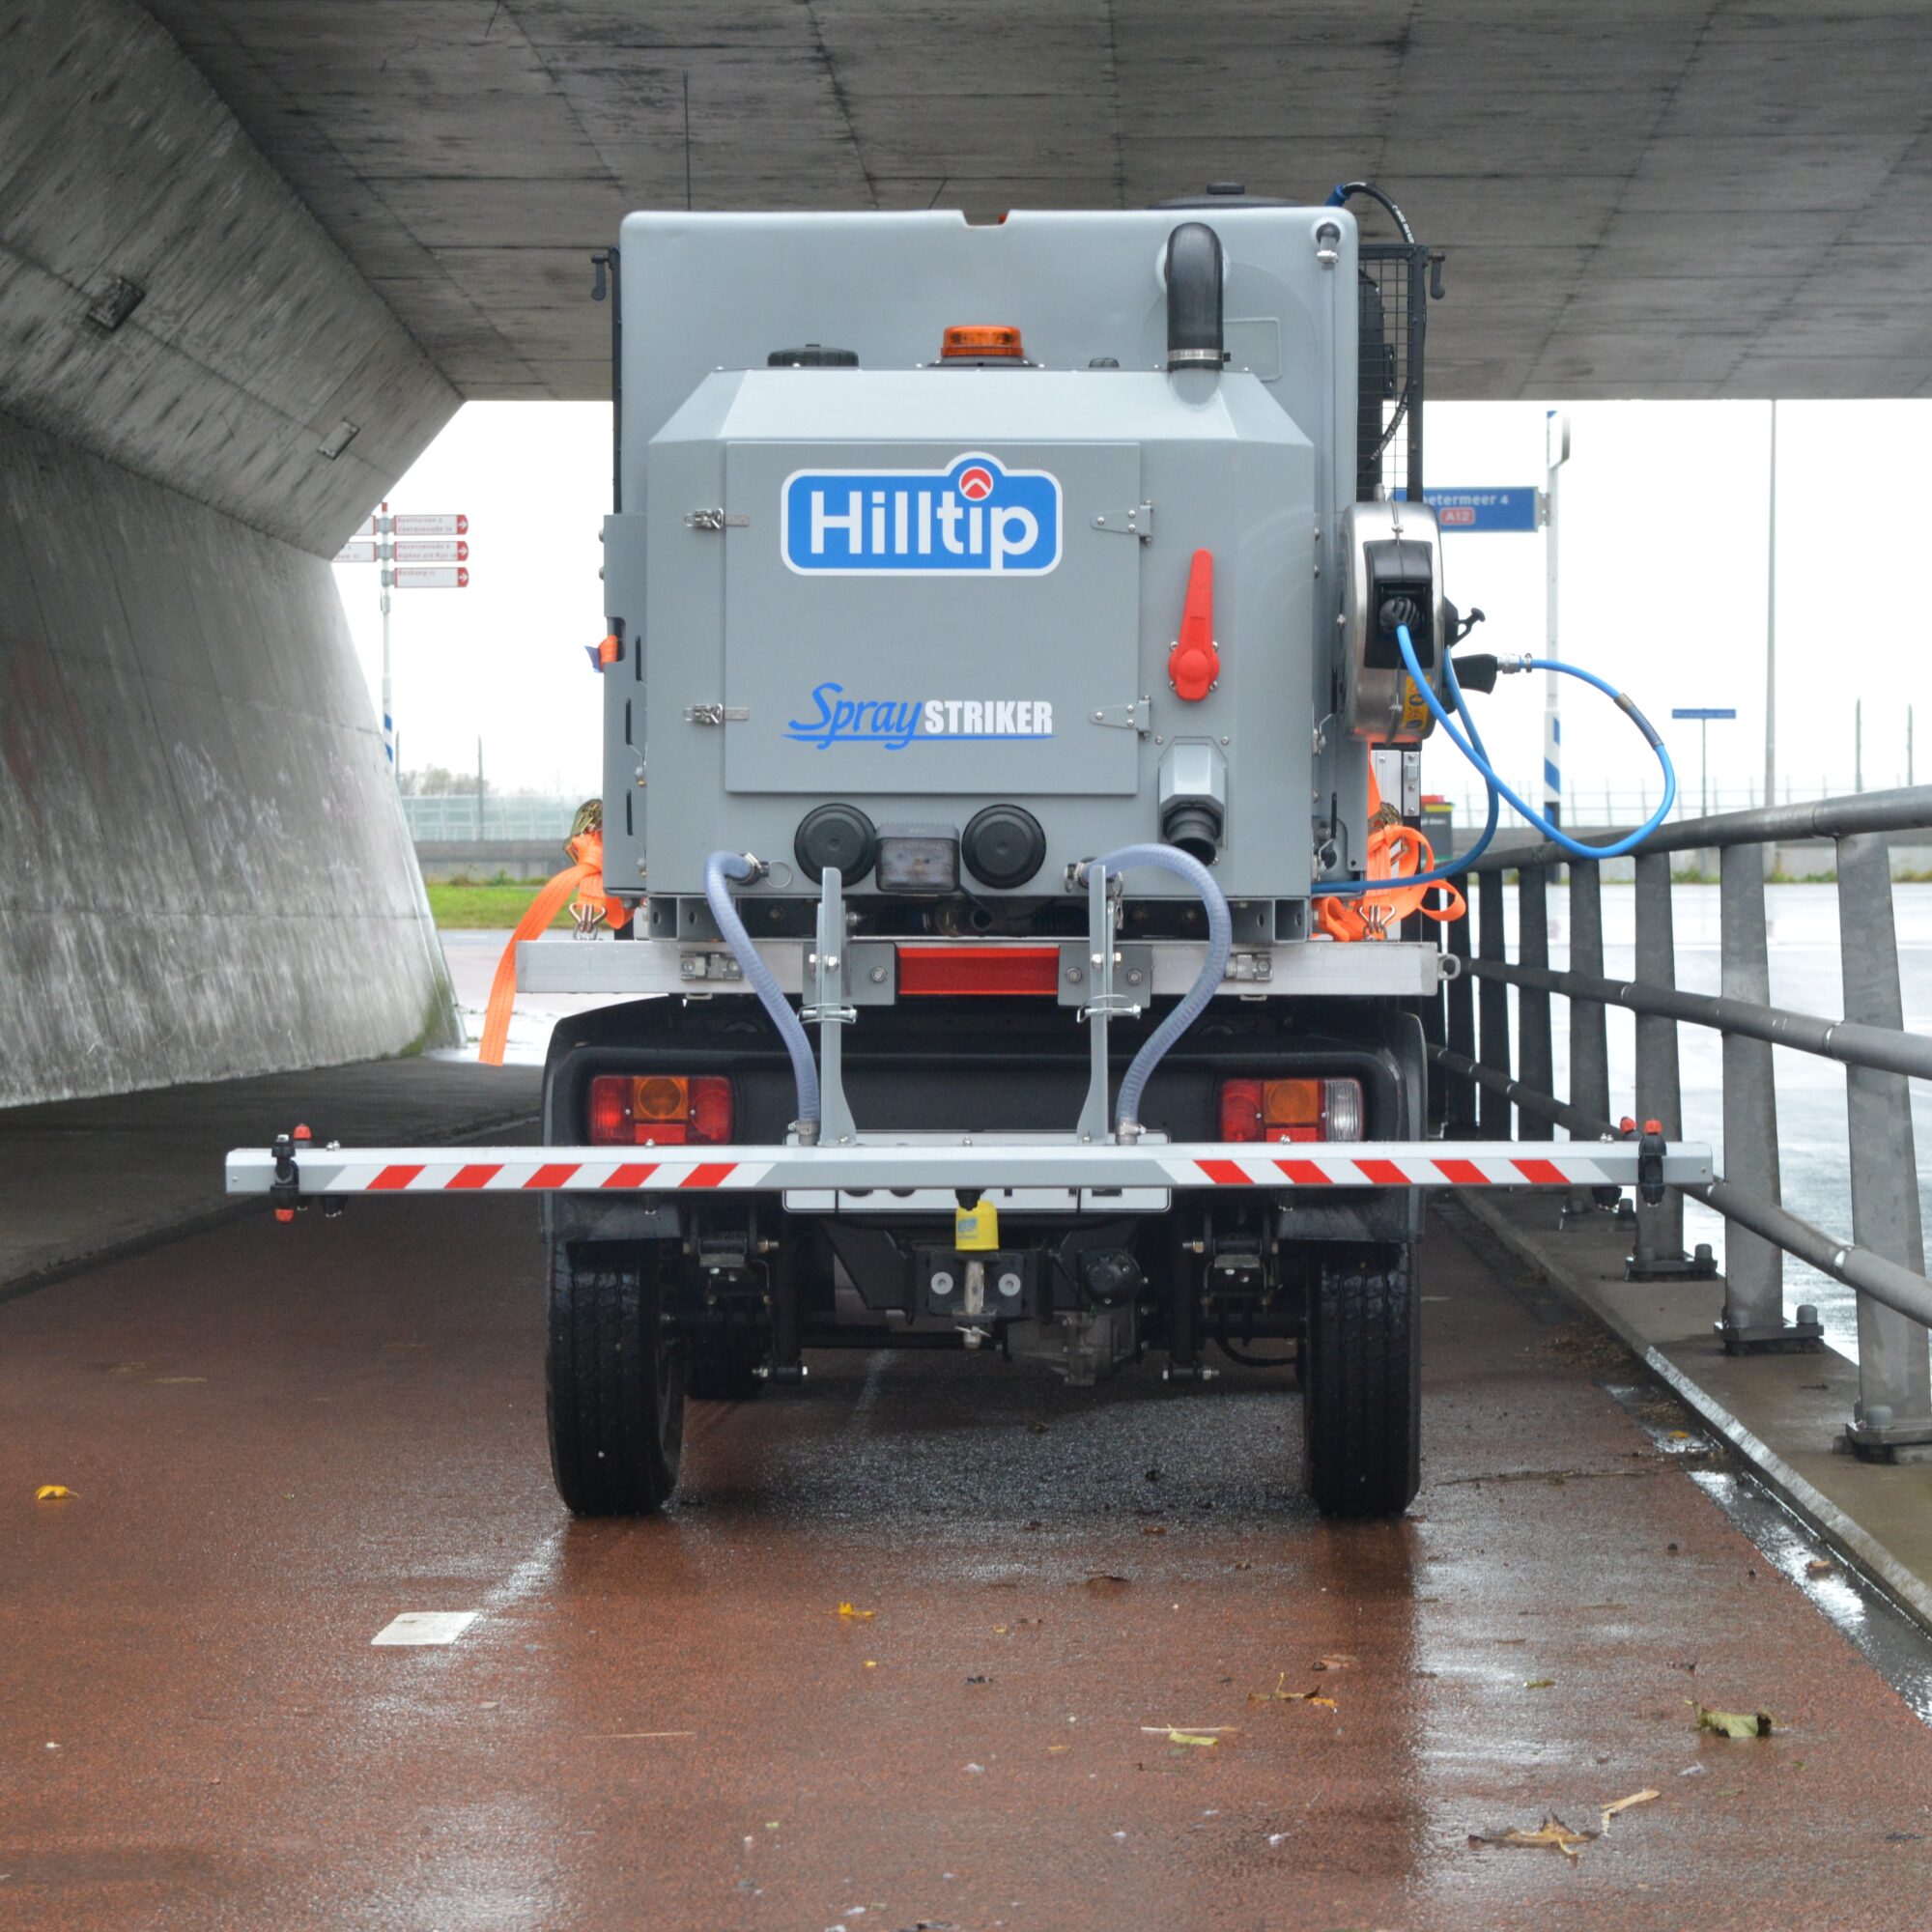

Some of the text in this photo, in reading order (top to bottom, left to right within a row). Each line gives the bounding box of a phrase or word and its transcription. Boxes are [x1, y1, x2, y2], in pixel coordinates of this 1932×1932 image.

[810, 468, 1039, 570] Hilltip
[1423, 494, 1509, 506] etermeer 4
[1445, 511, 1470, 523] A12
[787, 682, 1054, 750] Spray STRIKER
